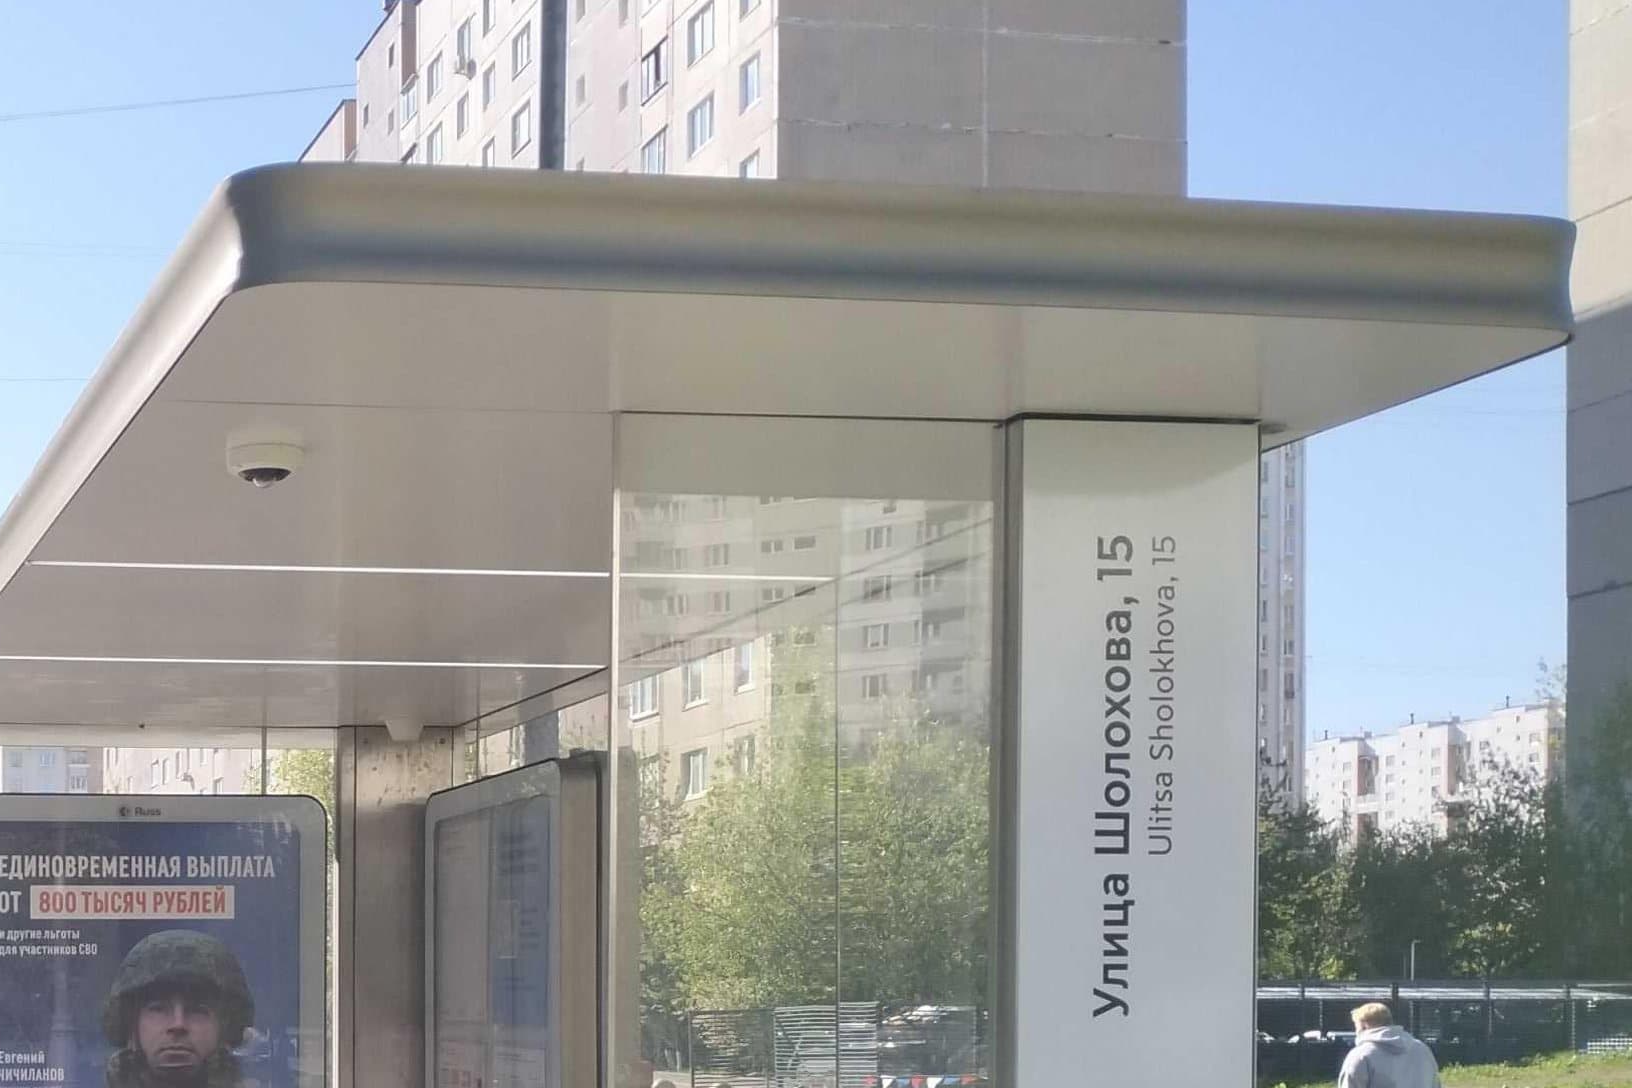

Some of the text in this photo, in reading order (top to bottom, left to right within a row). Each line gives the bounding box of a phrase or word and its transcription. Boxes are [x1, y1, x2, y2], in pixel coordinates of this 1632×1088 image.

[1149, 534, 1180, 856] Ulitsa Sholokhova, 15
[1093, 534, 1140, 1018] Улица Шолохова, 15
[187, 855, 276, 878] ВЫПЛАТА
[39, 890, 76, 913] 800
[83, 890, 147, 913] ТЫСЯЧ
[153, 885, 227, 914] РУБЛЕЙ
[6, 930, 42, 942] другие
[44, 930, 80, 940] льготы
[18, 945, 77, 957] участников
[78, 944, 98, 955] СВО
